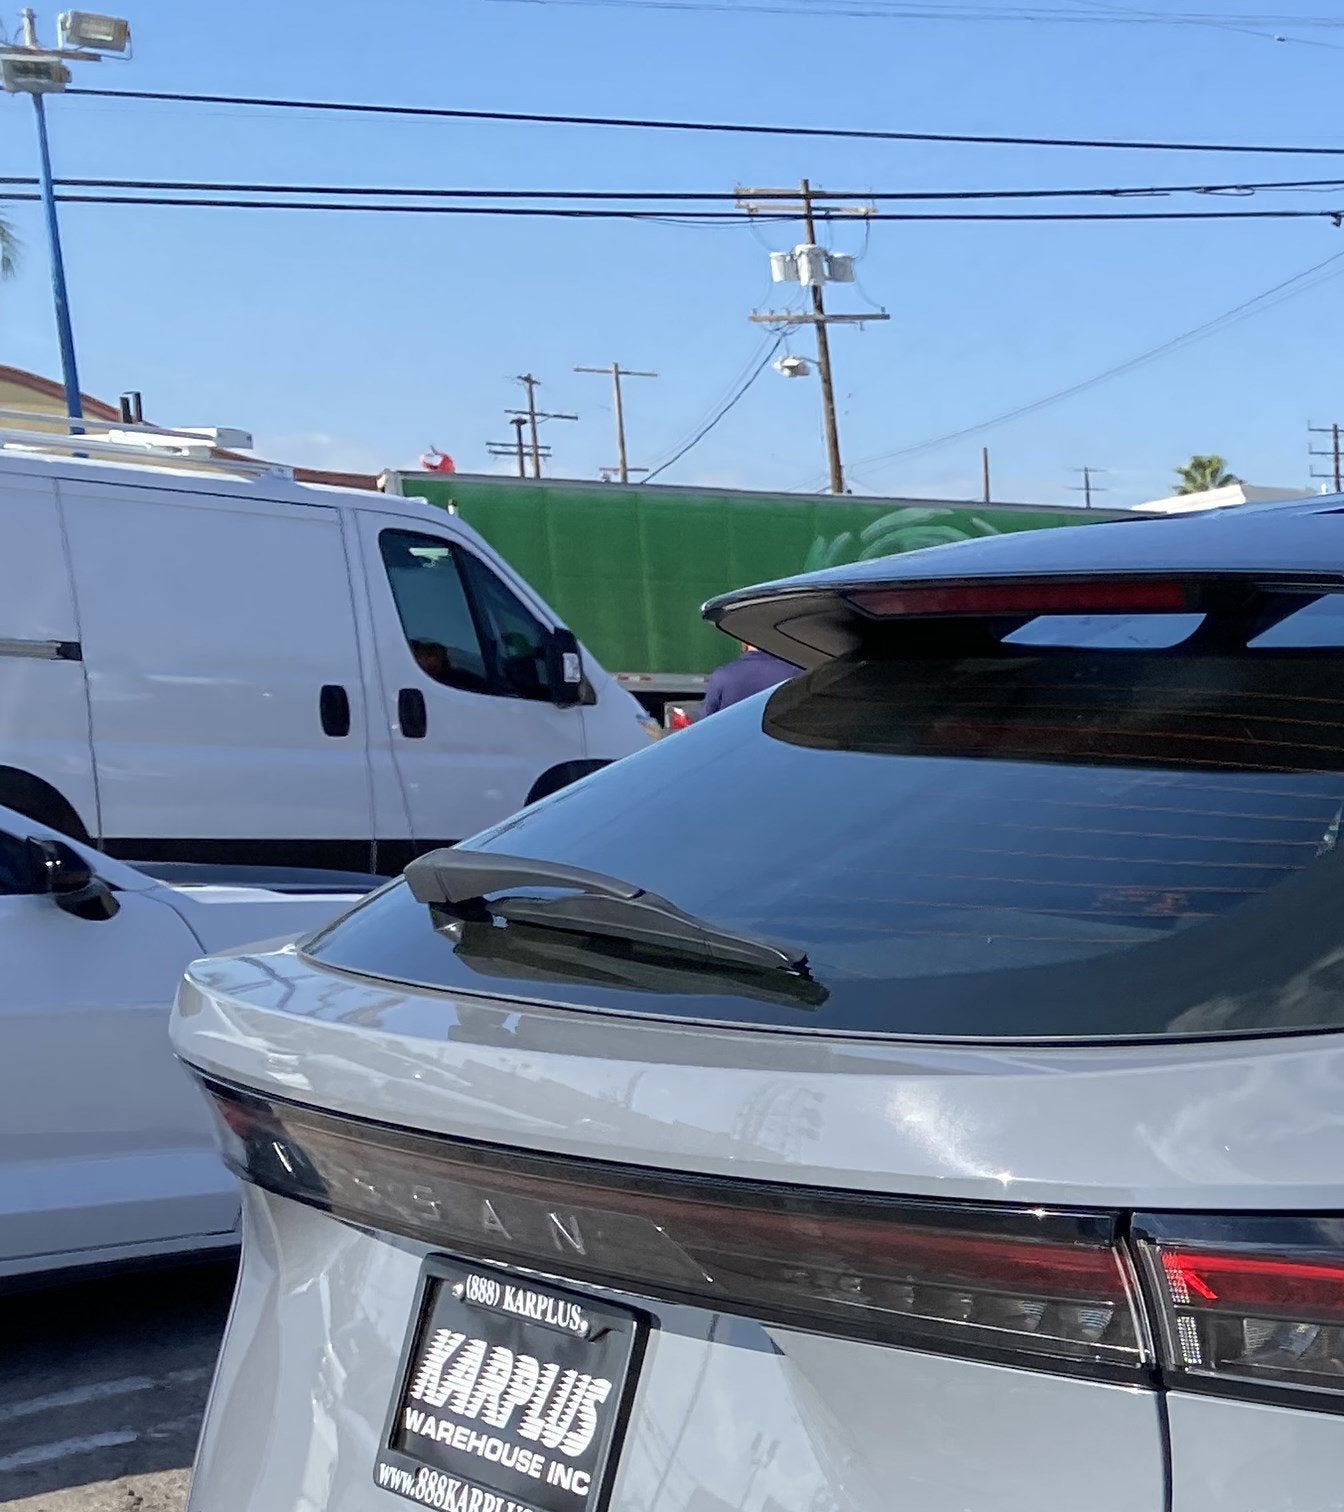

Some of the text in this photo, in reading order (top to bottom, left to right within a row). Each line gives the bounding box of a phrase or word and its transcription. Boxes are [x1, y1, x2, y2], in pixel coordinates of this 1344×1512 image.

[465, 1273, 583, 1330] (888) KARPLUS
[409, 1327, 613, 1458] KARPLUS
[405, 1406, 592, 1497] WAREHOUSE INC
